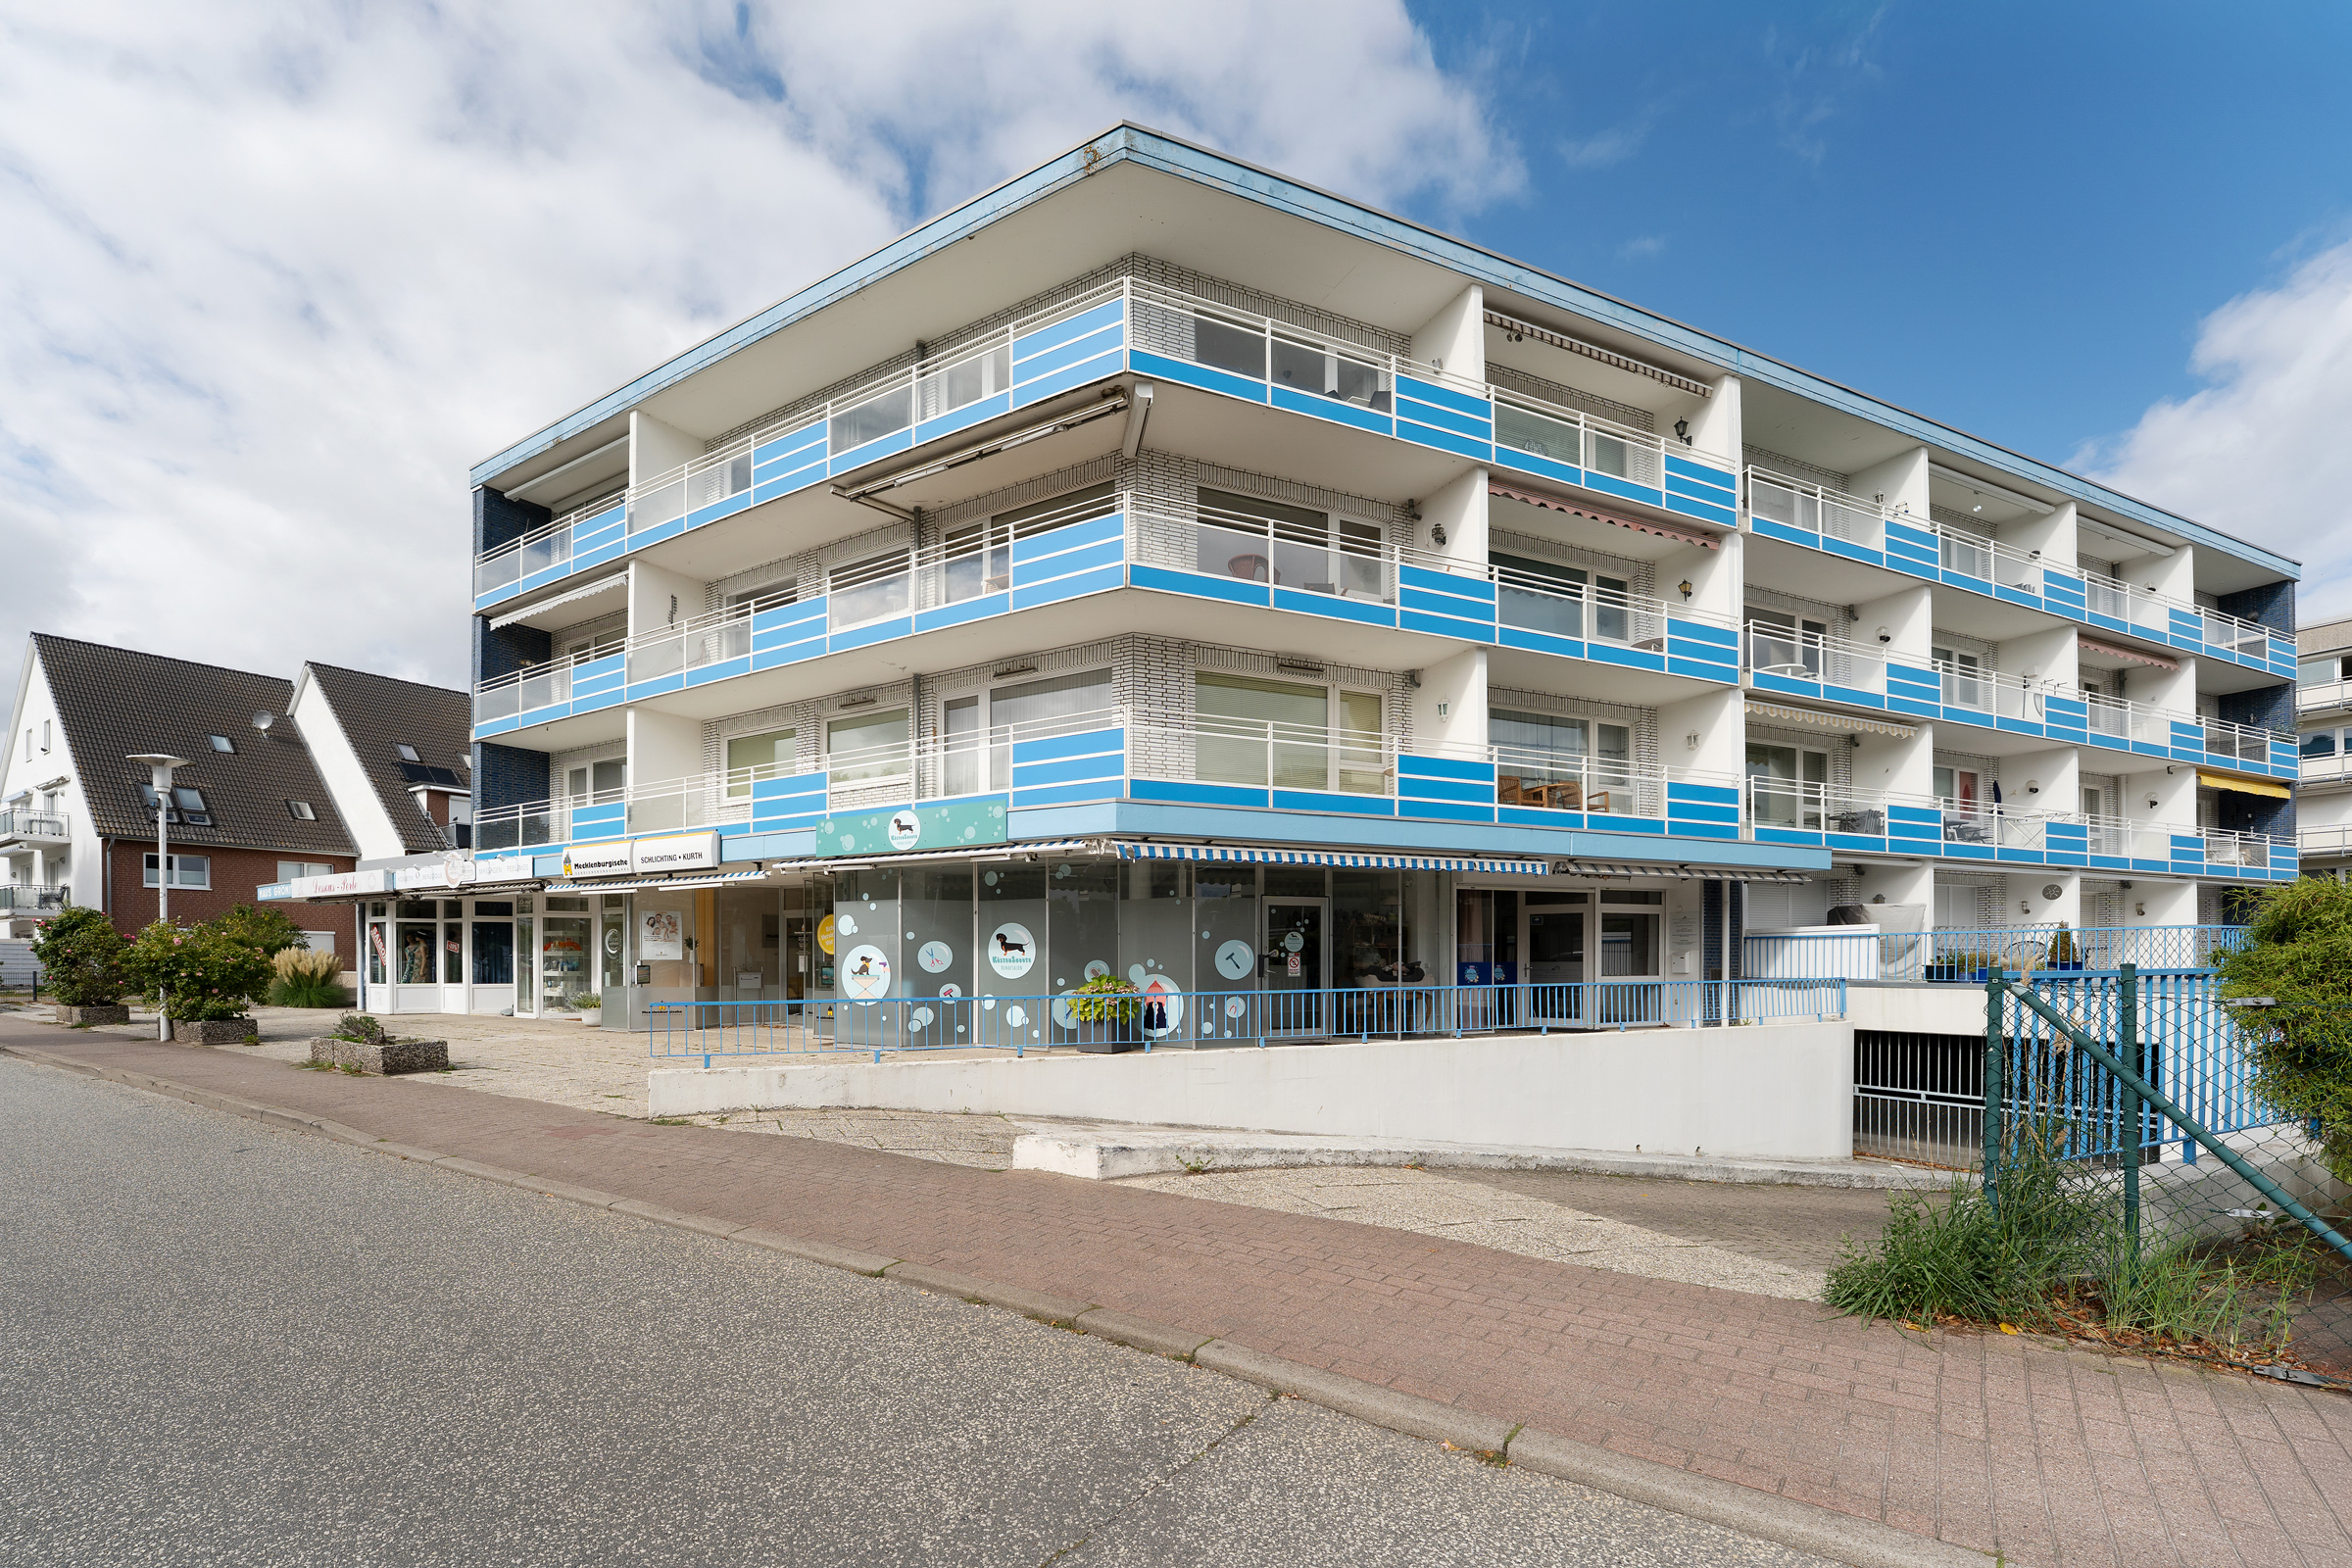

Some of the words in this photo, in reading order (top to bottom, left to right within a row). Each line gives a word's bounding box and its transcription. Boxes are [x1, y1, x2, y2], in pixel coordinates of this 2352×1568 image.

[574, 858, 628, 869] Mecklenburgische
[640, 855, 677, 864] SCHLICHTING
[683, 852, 703, 860] KURTH
[259, 888, 272, 899] HAUS
